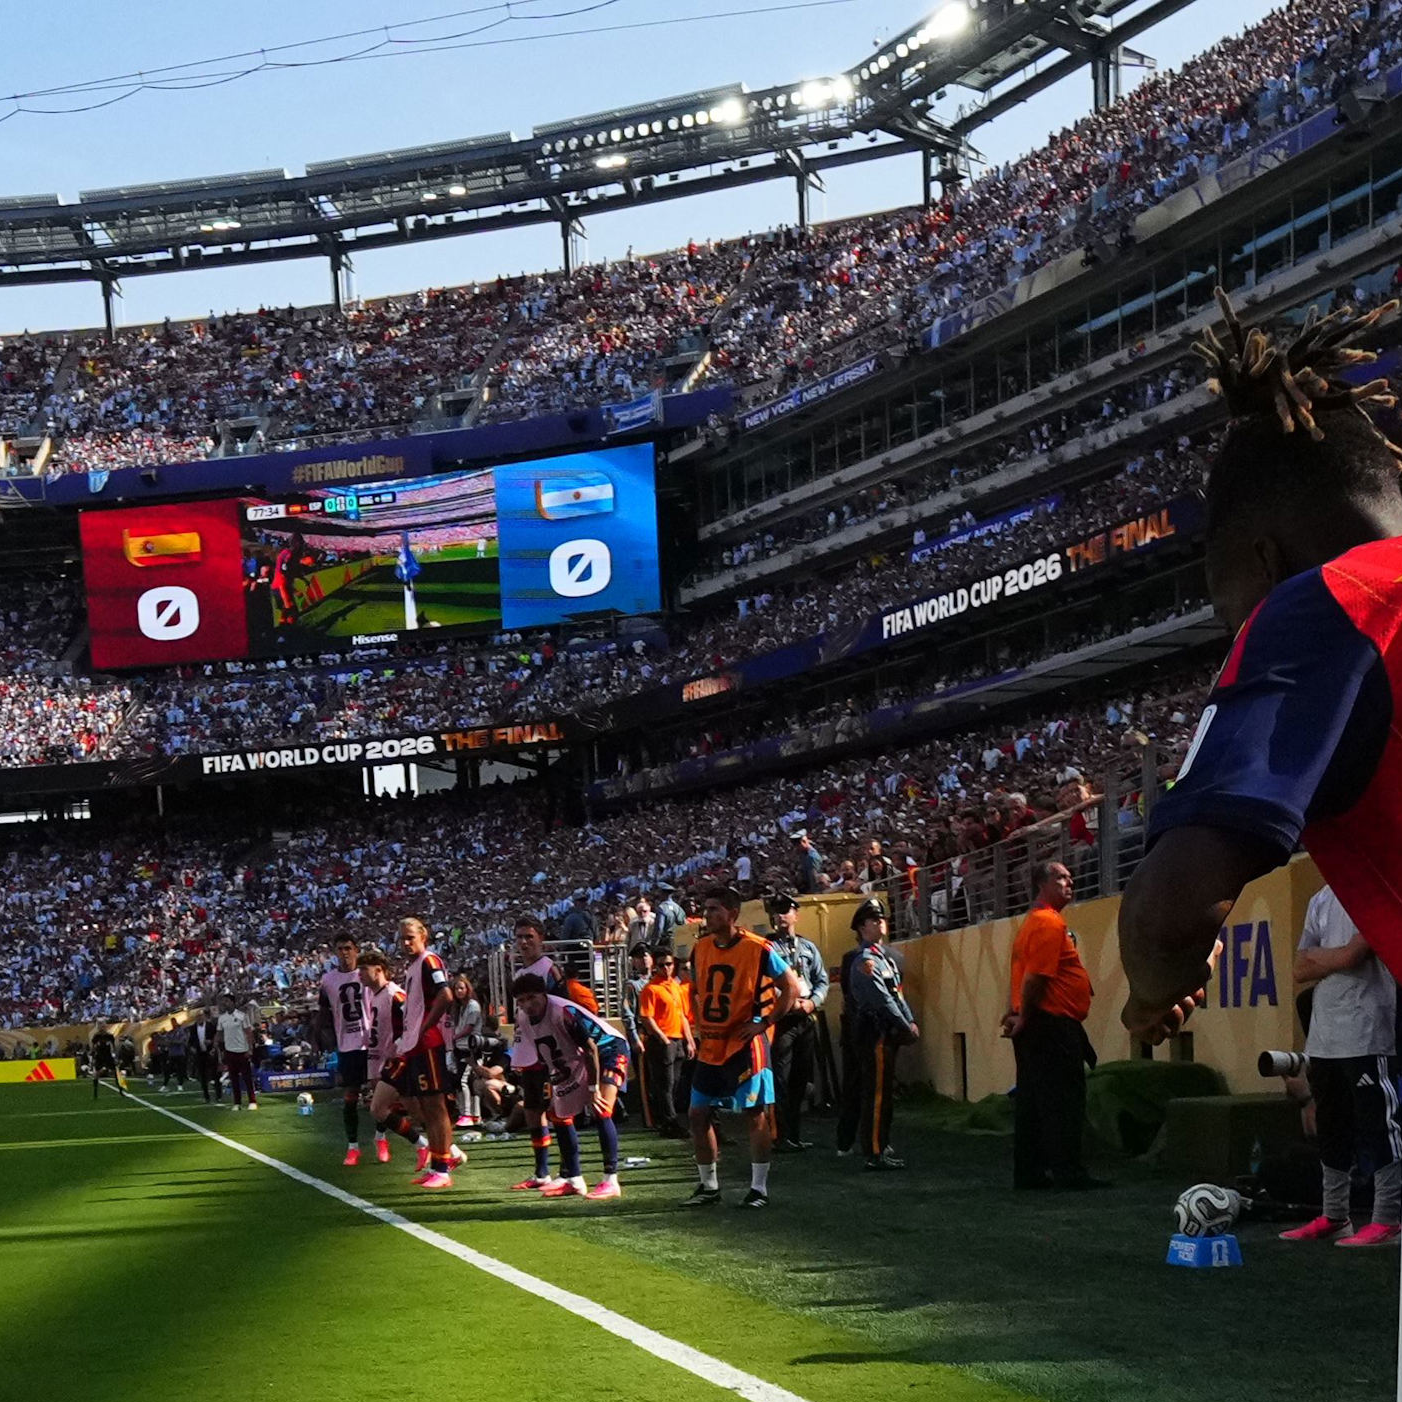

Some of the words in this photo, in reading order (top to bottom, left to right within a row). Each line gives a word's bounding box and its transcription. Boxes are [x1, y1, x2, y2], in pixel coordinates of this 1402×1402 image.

[746, 408, 770, 428] NEW
[803, 382, 828, 402] NEW
[830, 359, 876, 389] JERSEY
[292, 455, 404, 484] #FIFAWorldCup
[252, 506, 280, 518] 77:34
[549, 538, 612, 597] 0
[883, 611, 913, 639] FIFA
[914, 588, 969, 627] WORLD
[970, 575, 1003, 608] CUP
[1005, 553, 1062, 596] 2026
[1065, 532, 1108, 572] THE
[1110, 508, 1176, 553] FINAL
[137, 585, 199, 641] 0
[352, 633, 398, 645] Hisense
[203, 754, 245, 775] FIFA
[247, 746, 319, 769] WORLD
[321, 742, 362, 764] CUP
[365, 735, 435, 760] 2026
[441, 729, 491, 752] THE
[494, 721, 564, 743] FINAL
[1201, 920, 1278, 1008] IFA
